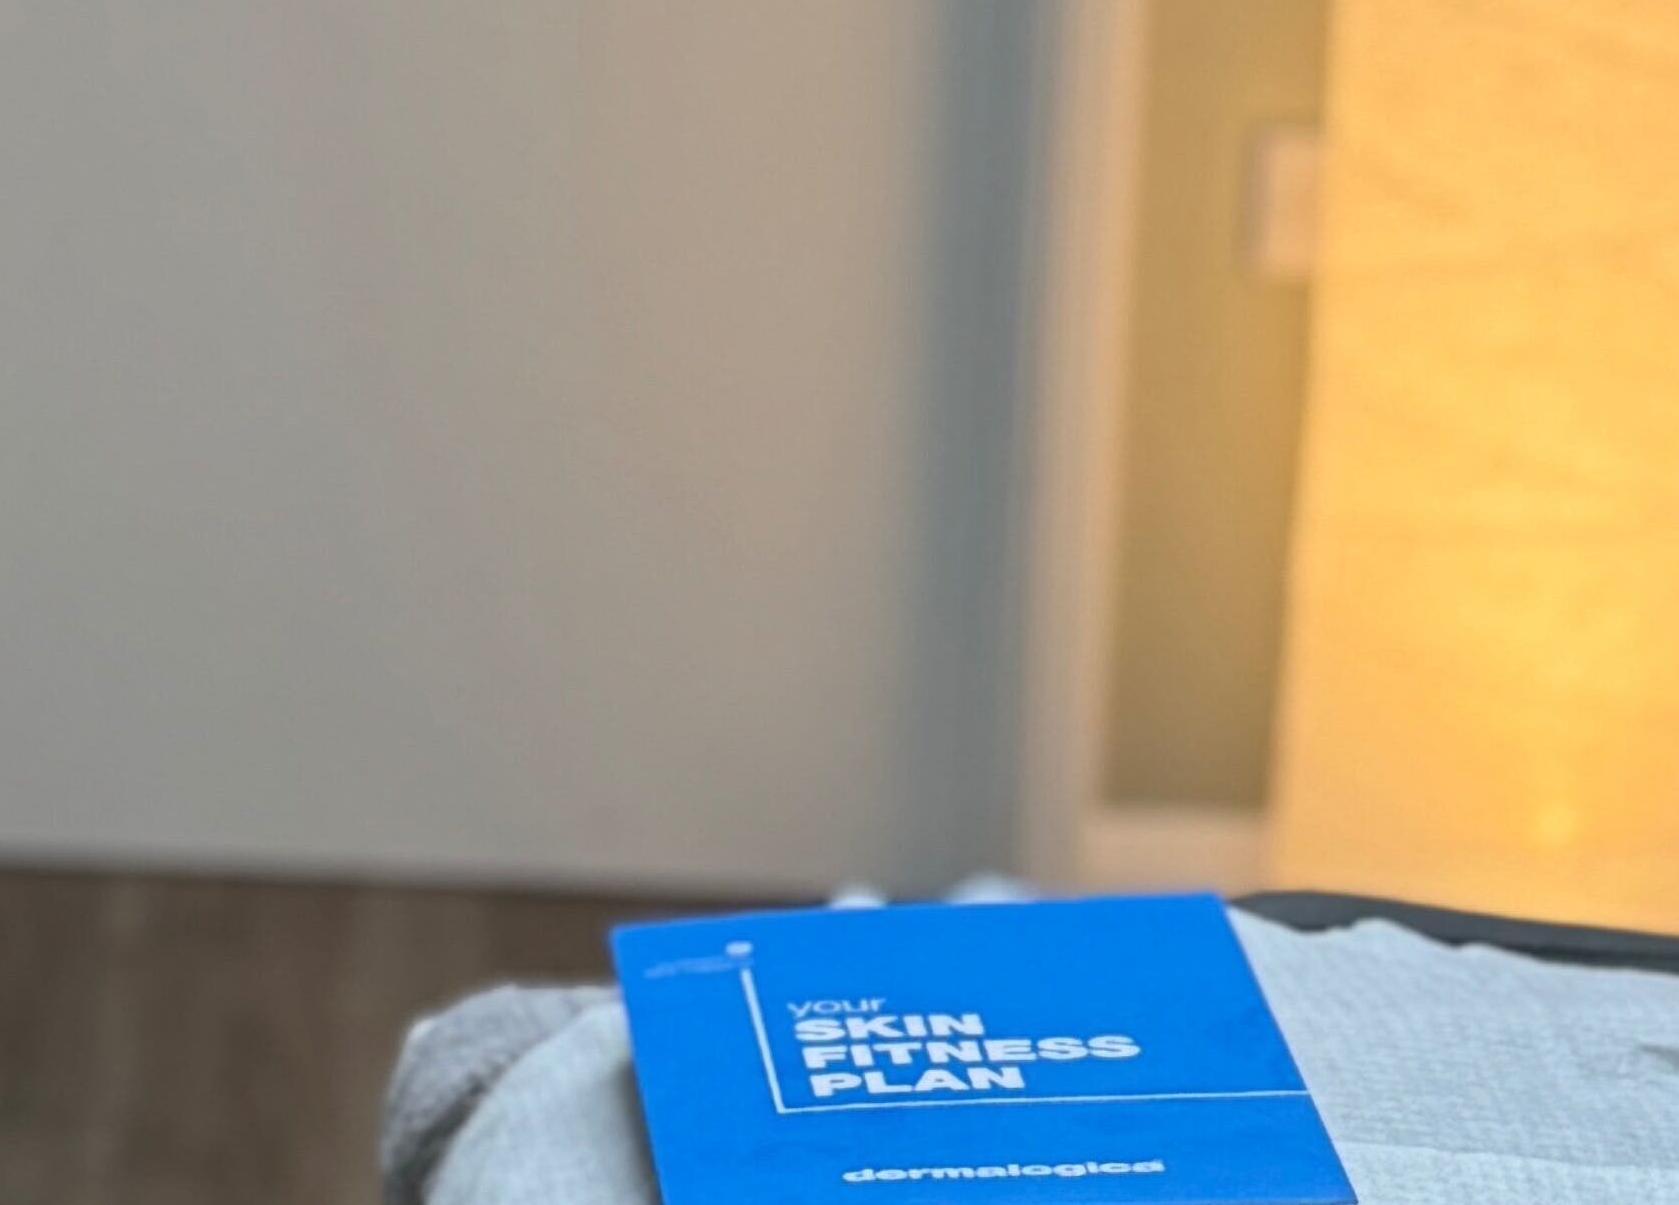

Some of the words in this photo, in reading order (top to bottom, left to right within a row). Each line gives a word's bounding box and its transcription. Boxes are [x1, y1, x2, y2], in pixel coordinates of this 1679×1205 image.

[787, 998, 886, 1018] your
[794, 1014, 985, 1041] SKIN
[802, 1035, 1142, 1070] FITNESS
[810, 1066, 1025, 1097] PLAN
[842, 1160, 1166, 1182] dermalogica
